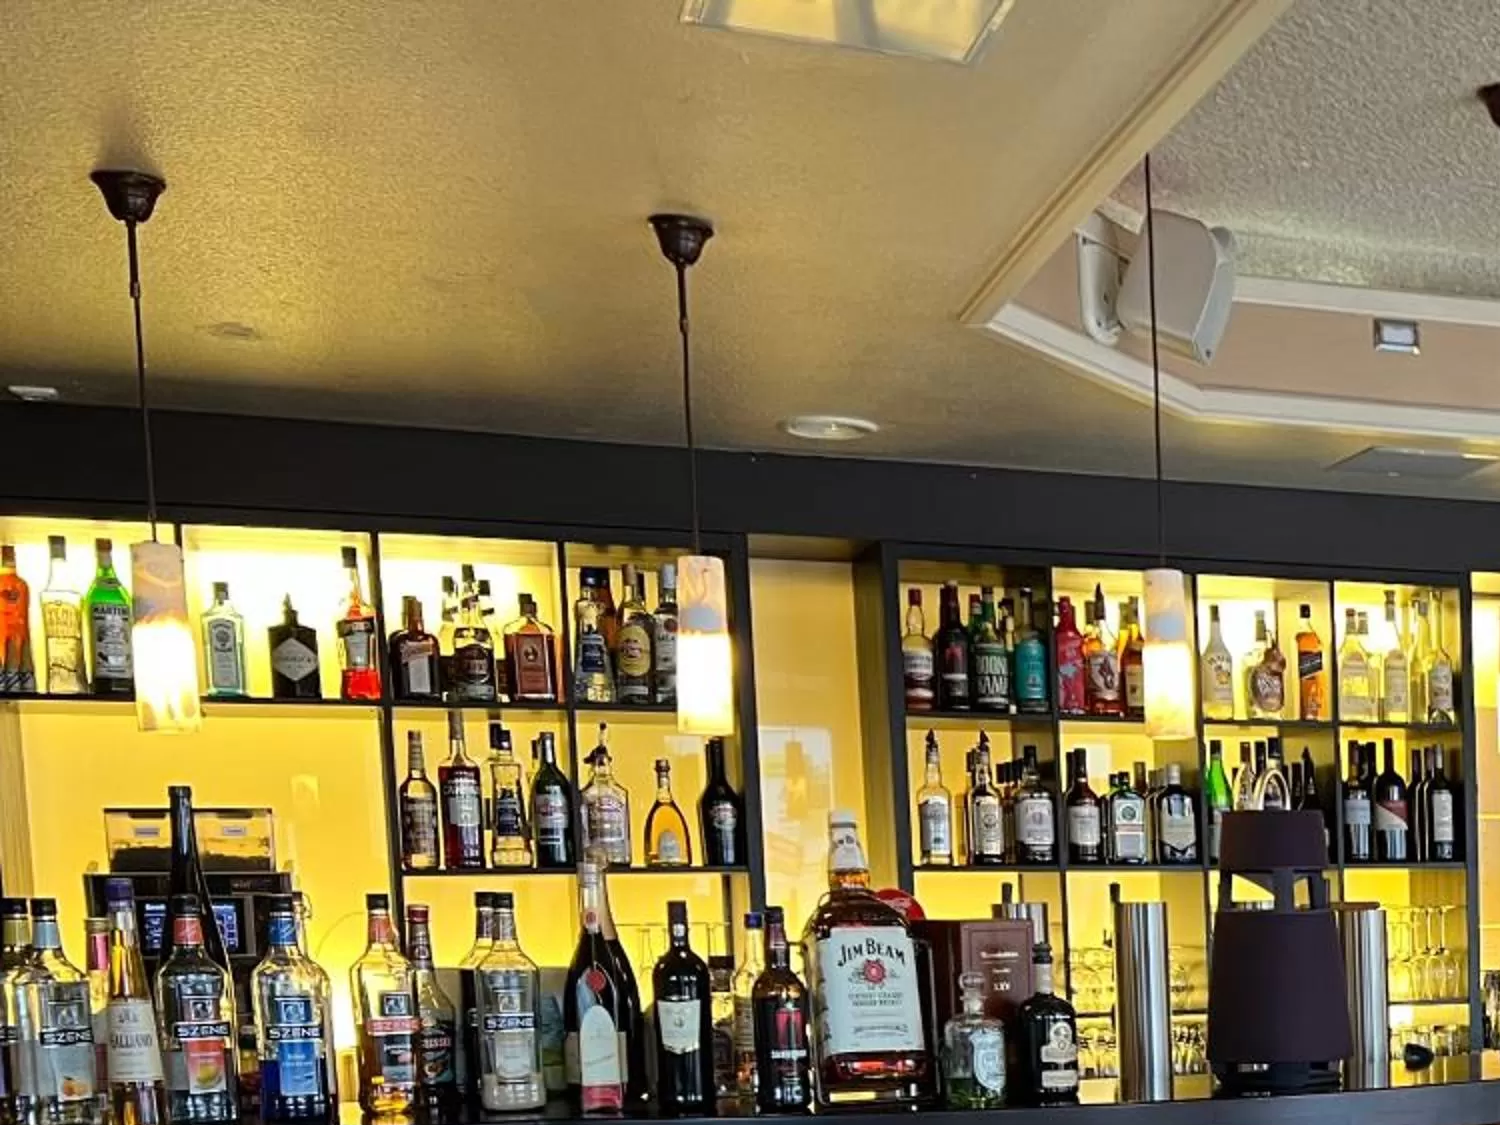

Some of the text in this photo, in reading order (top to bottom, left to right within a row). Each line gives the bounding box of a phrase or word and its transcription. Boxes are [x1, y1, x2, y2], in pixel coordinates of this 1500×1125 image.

[837, 937, 906, 967] JIM BEAM
[373, 1019, 419, 1032] SZENE
[486, 1017, 534, 1029] SZENE
[43, 1030, 93, 1043] SZENE
[177, 1025, 229, 1036] SZENE
[269, 1027, 321, 1038] SZENE
